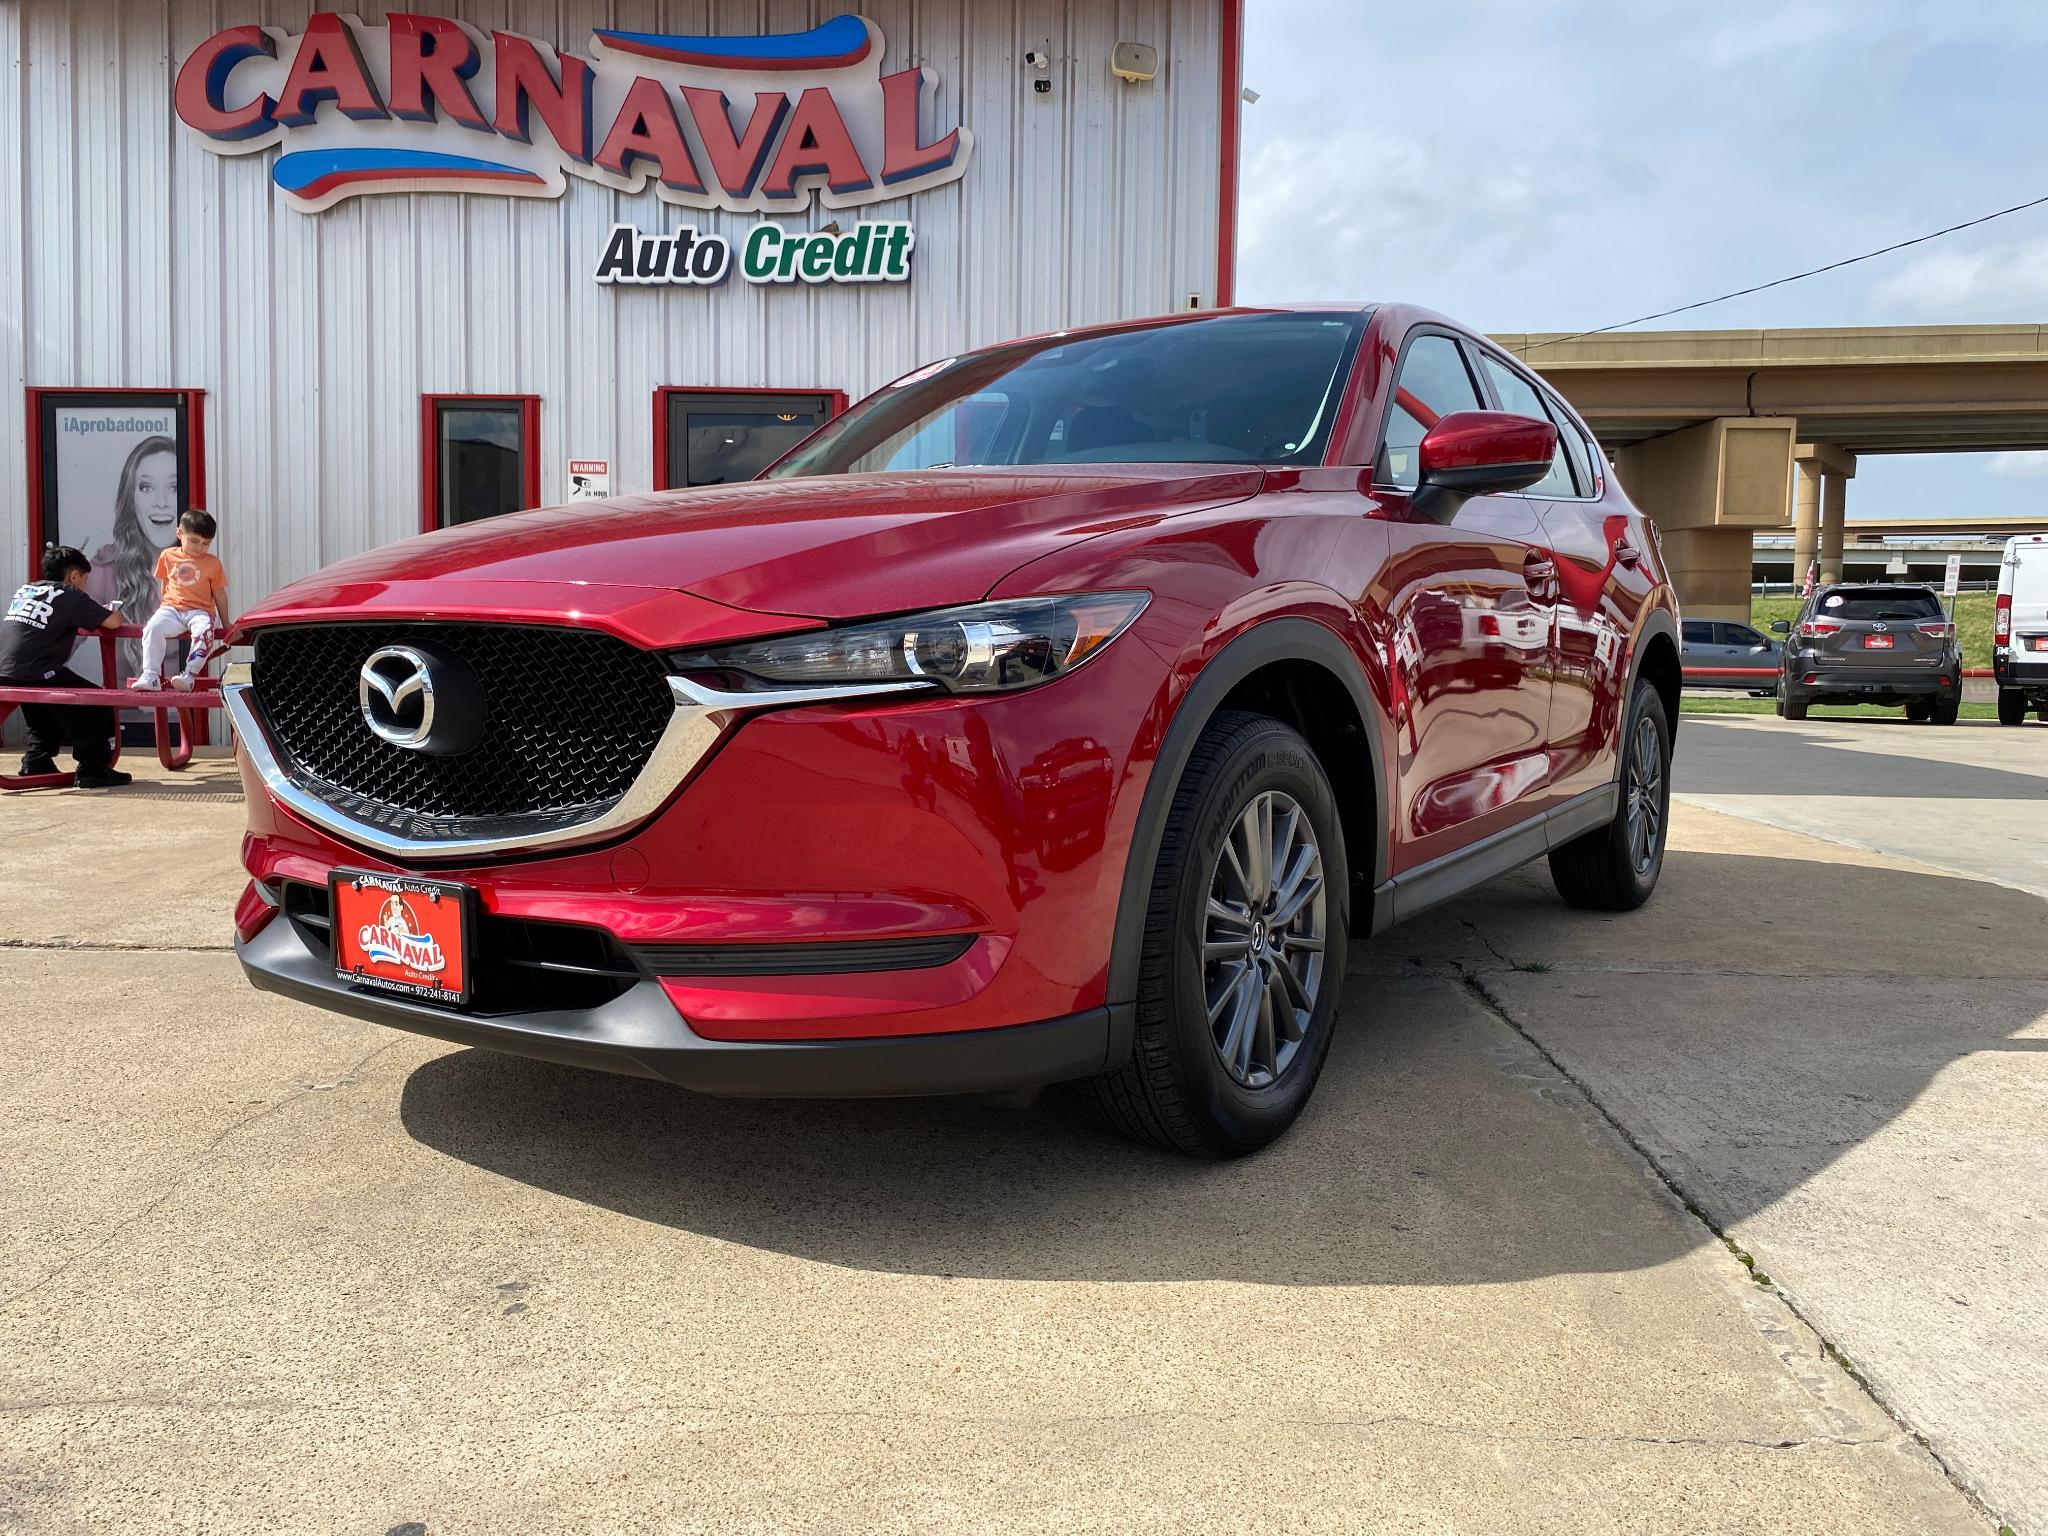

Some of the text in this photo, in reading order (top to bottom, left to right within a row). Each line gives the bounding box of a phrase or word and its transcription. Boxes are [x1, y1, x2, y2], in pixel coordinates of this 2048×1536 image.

[173, 11, 961, 200] CARNAVAL
[597, 223, 912, 283] Auto Credit
[572, 463, 605, 473] WARNING
[359, 875, 442, 896] CARNAVAL Auto Credit
[359, 925, 444, 966] CARNAVAL
[336, 971, 460, 1003] www.CarnavalAutos.com 972-241-8141
[404, 970, 436, 981] Auto Credit
